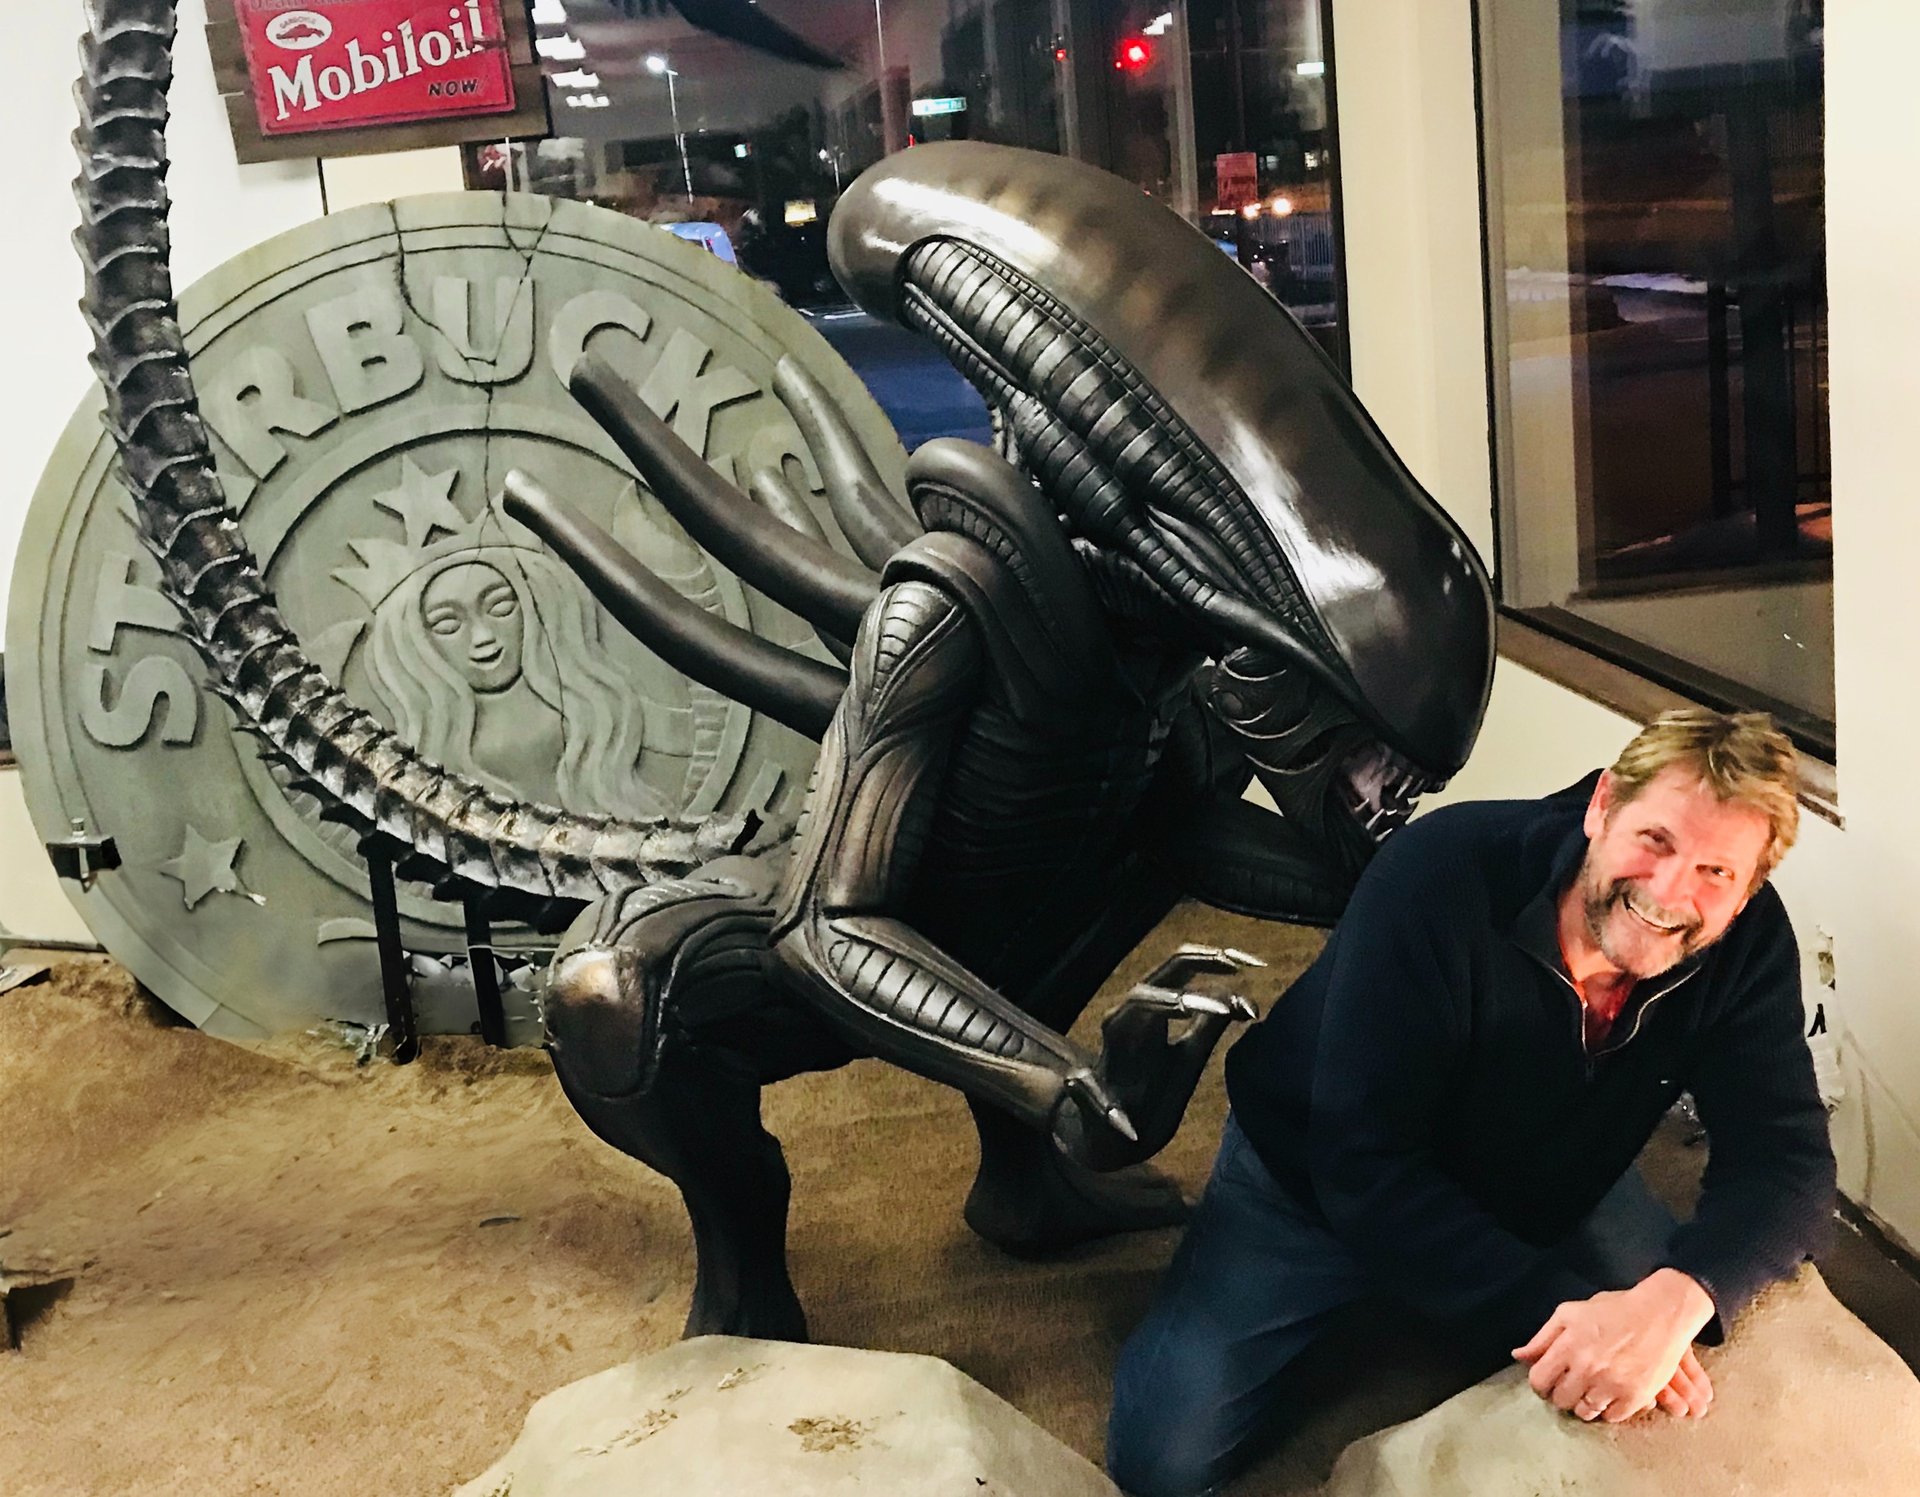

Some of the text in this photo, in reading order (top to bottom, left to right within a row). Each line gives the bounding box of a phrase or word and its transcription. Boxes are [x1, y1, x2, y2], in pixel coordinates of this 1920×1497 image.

[267, 0, 486, 121] Mobiloil
[428, 78, 479, 97] NOW
[78, 275, 828, 748] STRBUCK
